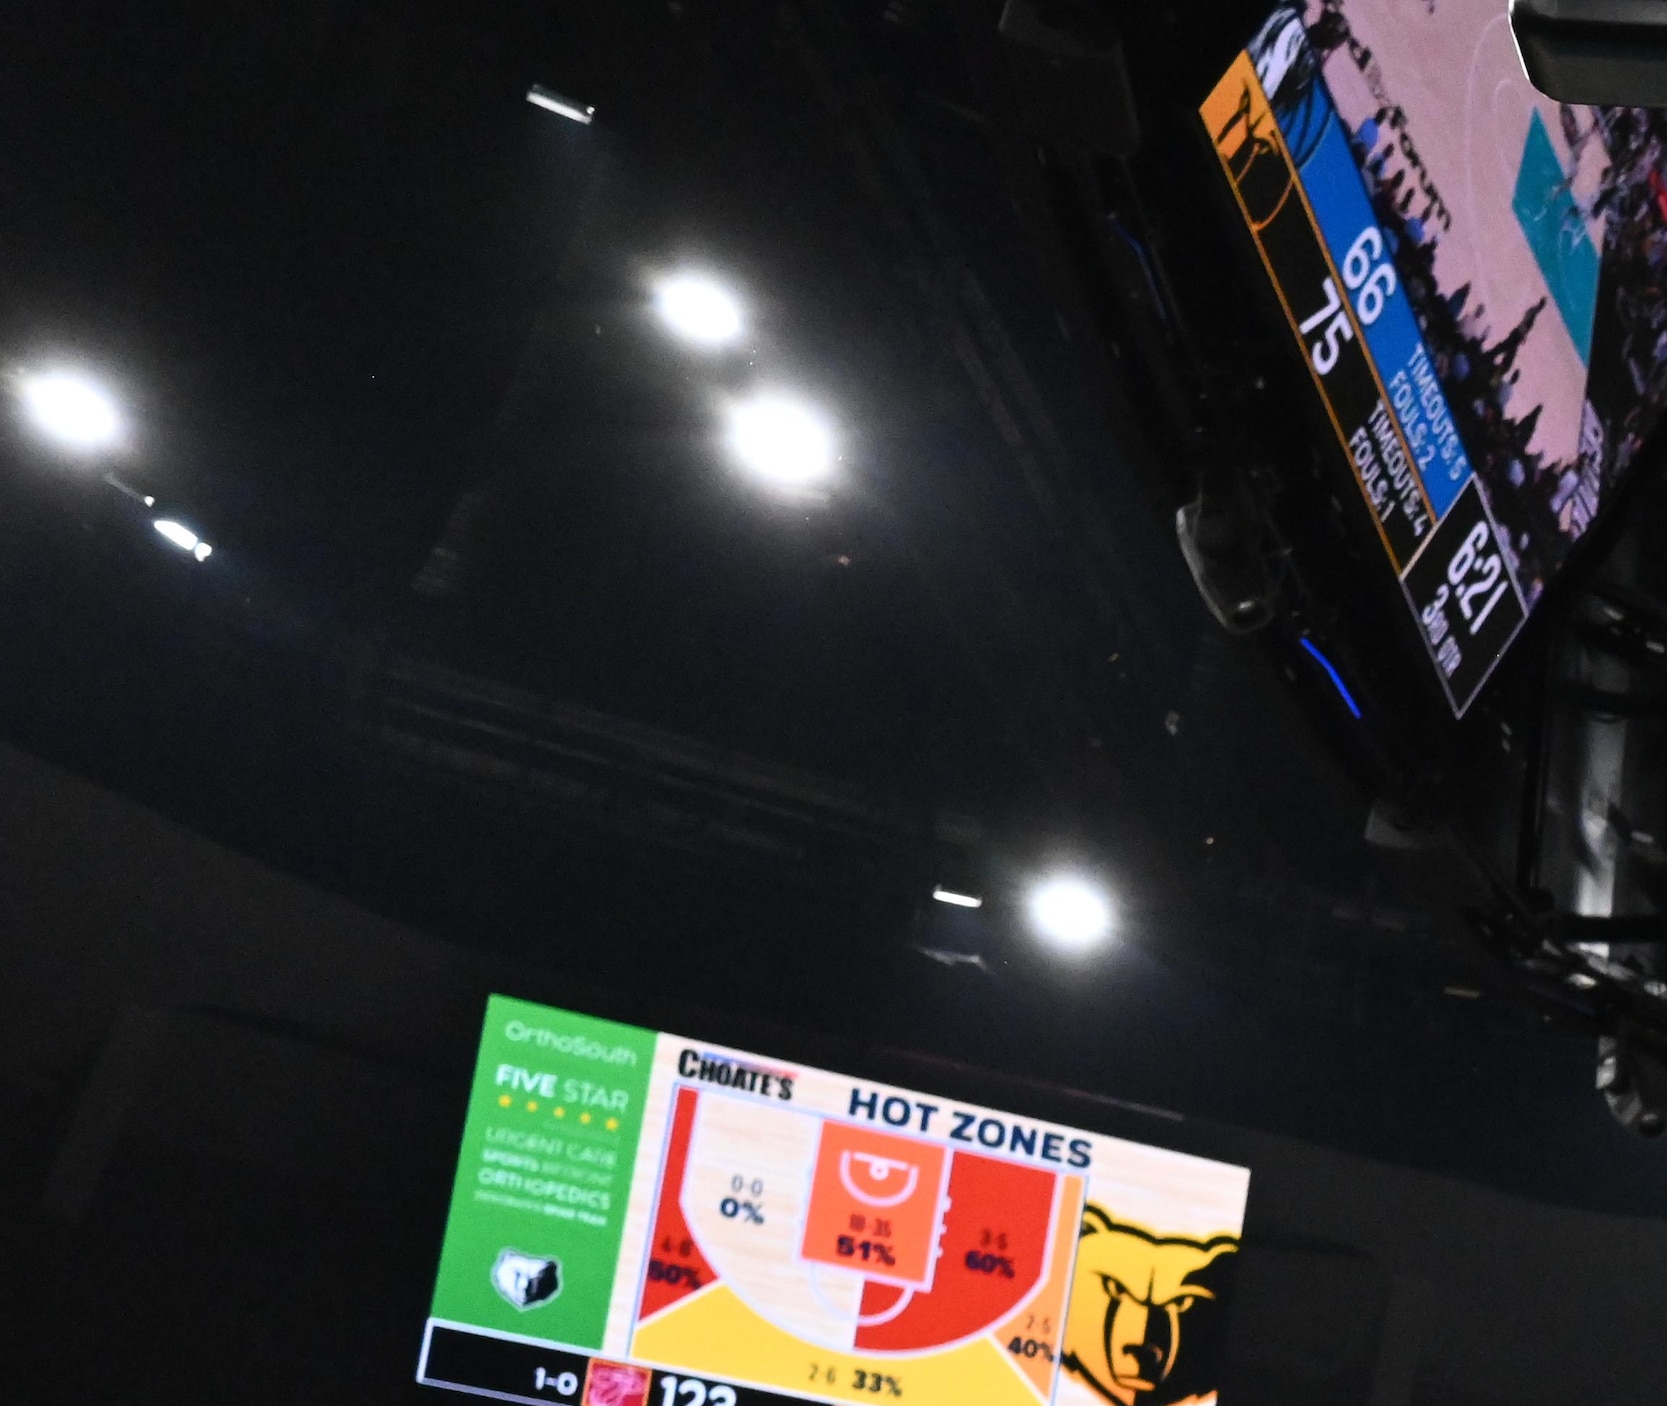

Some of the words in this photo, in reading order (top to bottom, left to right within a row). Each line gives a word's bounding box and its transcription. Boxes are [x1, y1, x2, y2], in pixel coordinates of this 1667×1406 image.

[1343, 226, 1397, 325] 66
[1300, 277, 1354, 376] 75
[1389, 370, 1427, 456] FOULS:
[1418, 454, 1436, 472] 2
[1407, 343, 1457, 462] TIMEOUTS:
[1448, 456, 1467, 481] 5
[1349, 426, 1387, 511] FOULS:
[1367, 401, 1419, 517] TIMEOUTS:
[1413, 511, 1426, 537] 4
[1447, 520, 1509, 635] 6:21
[505, 1020, 638, 1066] OrthoSouth
[495, 1063, 558, 1098] FIVE
[563, 1078, 629, 1114] STAR
[849, 1088, 939, 1132] HOT
[949, 1111, 1093, 1169] ZONES
[720, 1198, 764, 1225] 0%
[649, 1259, 701, 1290] 50%
[836, 1234, 895, 1266] 51%
[964, 1250, 1015, 1279] 60%
[1007, 1336, 1054, 1362] 40%
[534, 1366, 578, 1396] 1-0
[852, 1369, 902, 1397] 33%
